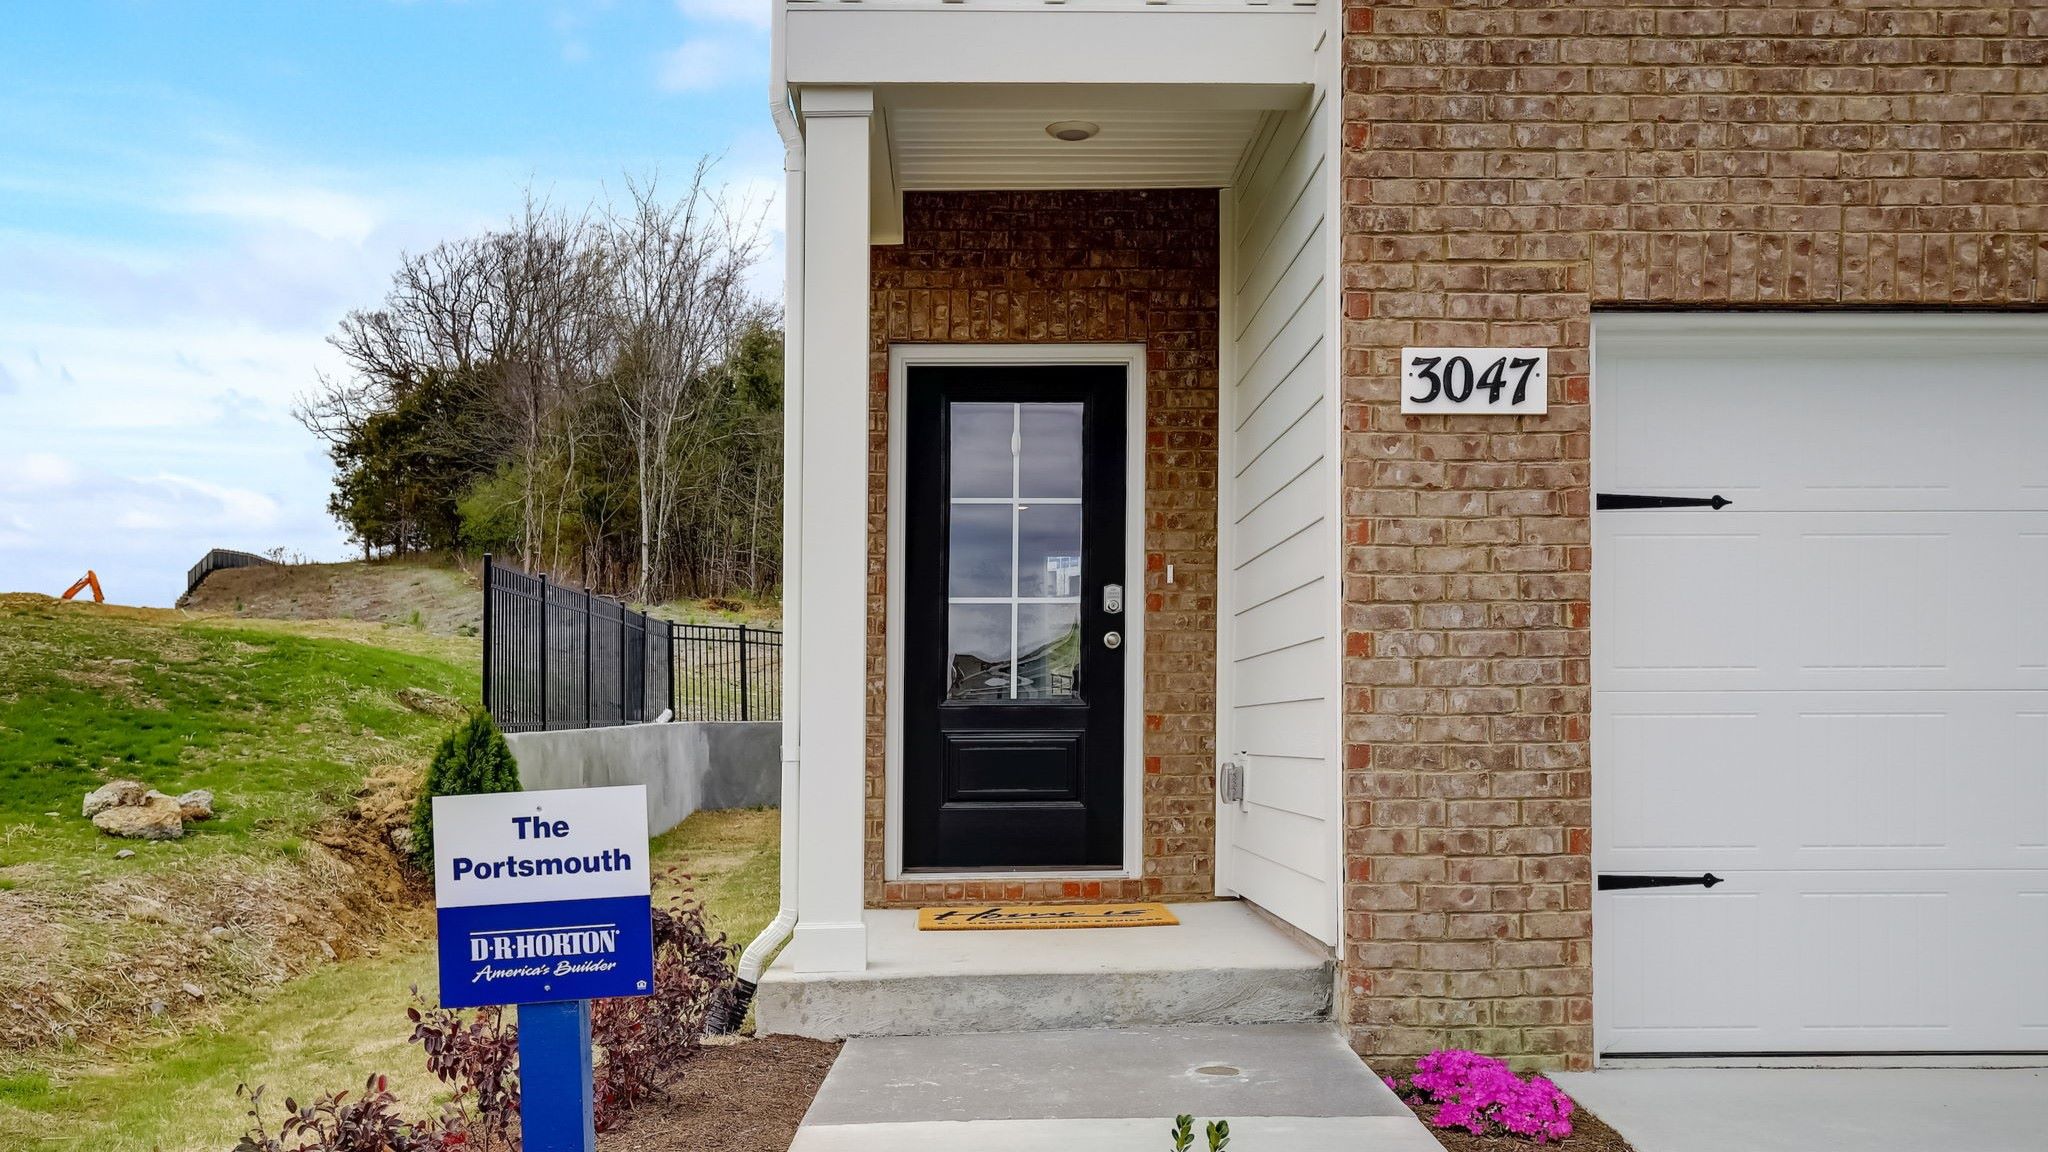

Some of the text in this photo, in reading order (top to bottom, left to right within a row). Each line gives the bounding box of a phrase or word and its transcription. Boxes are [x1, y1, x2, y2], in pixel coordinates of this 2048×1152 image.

[1409, 356, 1540, 406] 3047
[511, 816, 570, 839] The
[452, 848, 632, 881] Portsmouth
[471, 958, 617, 983] America's Builder
